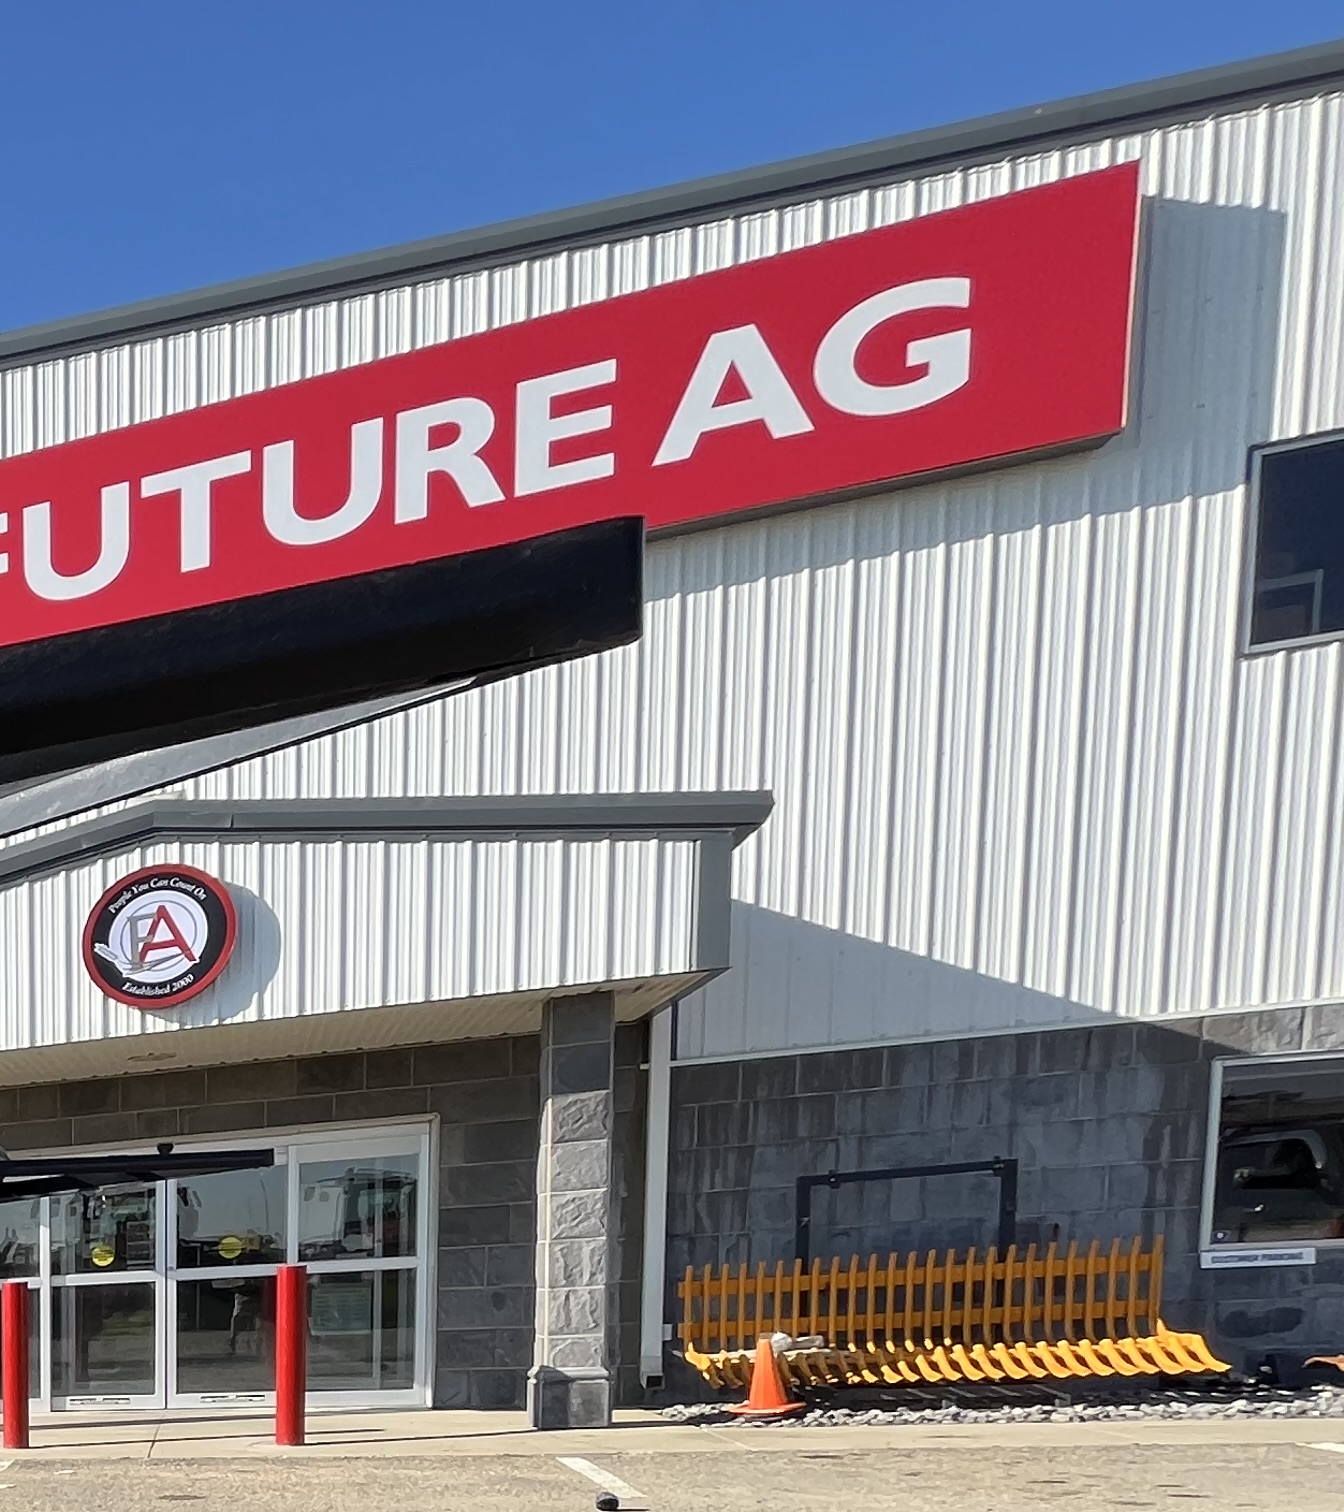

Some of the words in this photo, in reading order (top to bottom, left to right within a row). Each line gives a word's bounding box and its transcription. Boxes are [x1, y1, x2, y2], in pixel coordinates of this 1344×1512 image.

[652, 276, 972, 468] AG
[132, 883, 149, 895] You
[150, 877, 168, 888] Can
[170, 877, 195, 893] Count
[193, 887, 207, 901] On
[122, 982, 170, 996] Established
[172, 973, 194, 992] 2000
